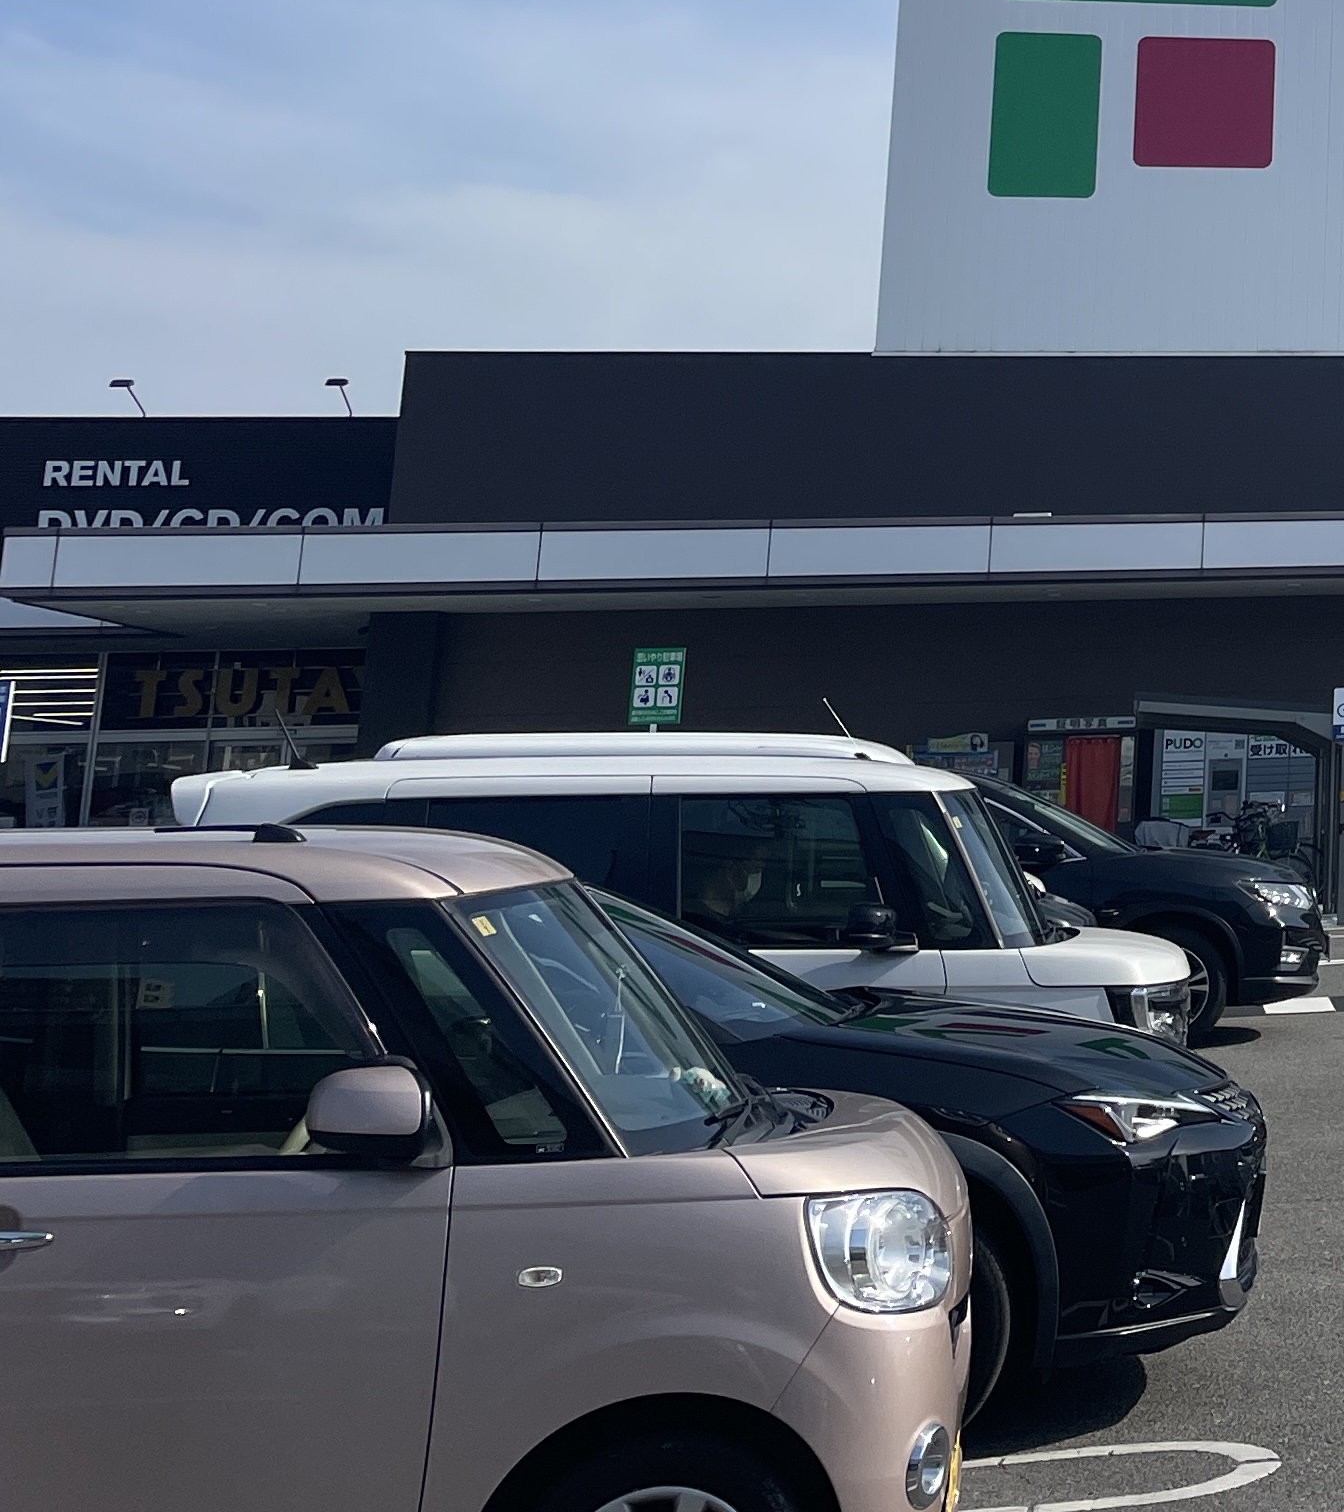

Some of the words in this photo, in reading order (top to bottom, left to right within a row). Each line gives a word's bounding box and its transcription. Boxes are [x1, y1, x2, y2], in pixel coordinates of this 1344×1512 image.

[43, 460, 190, 487] RENTAL
[136, 666, 363, 719] TSUTA
[1165, 737, 1204, 750] PUDO
